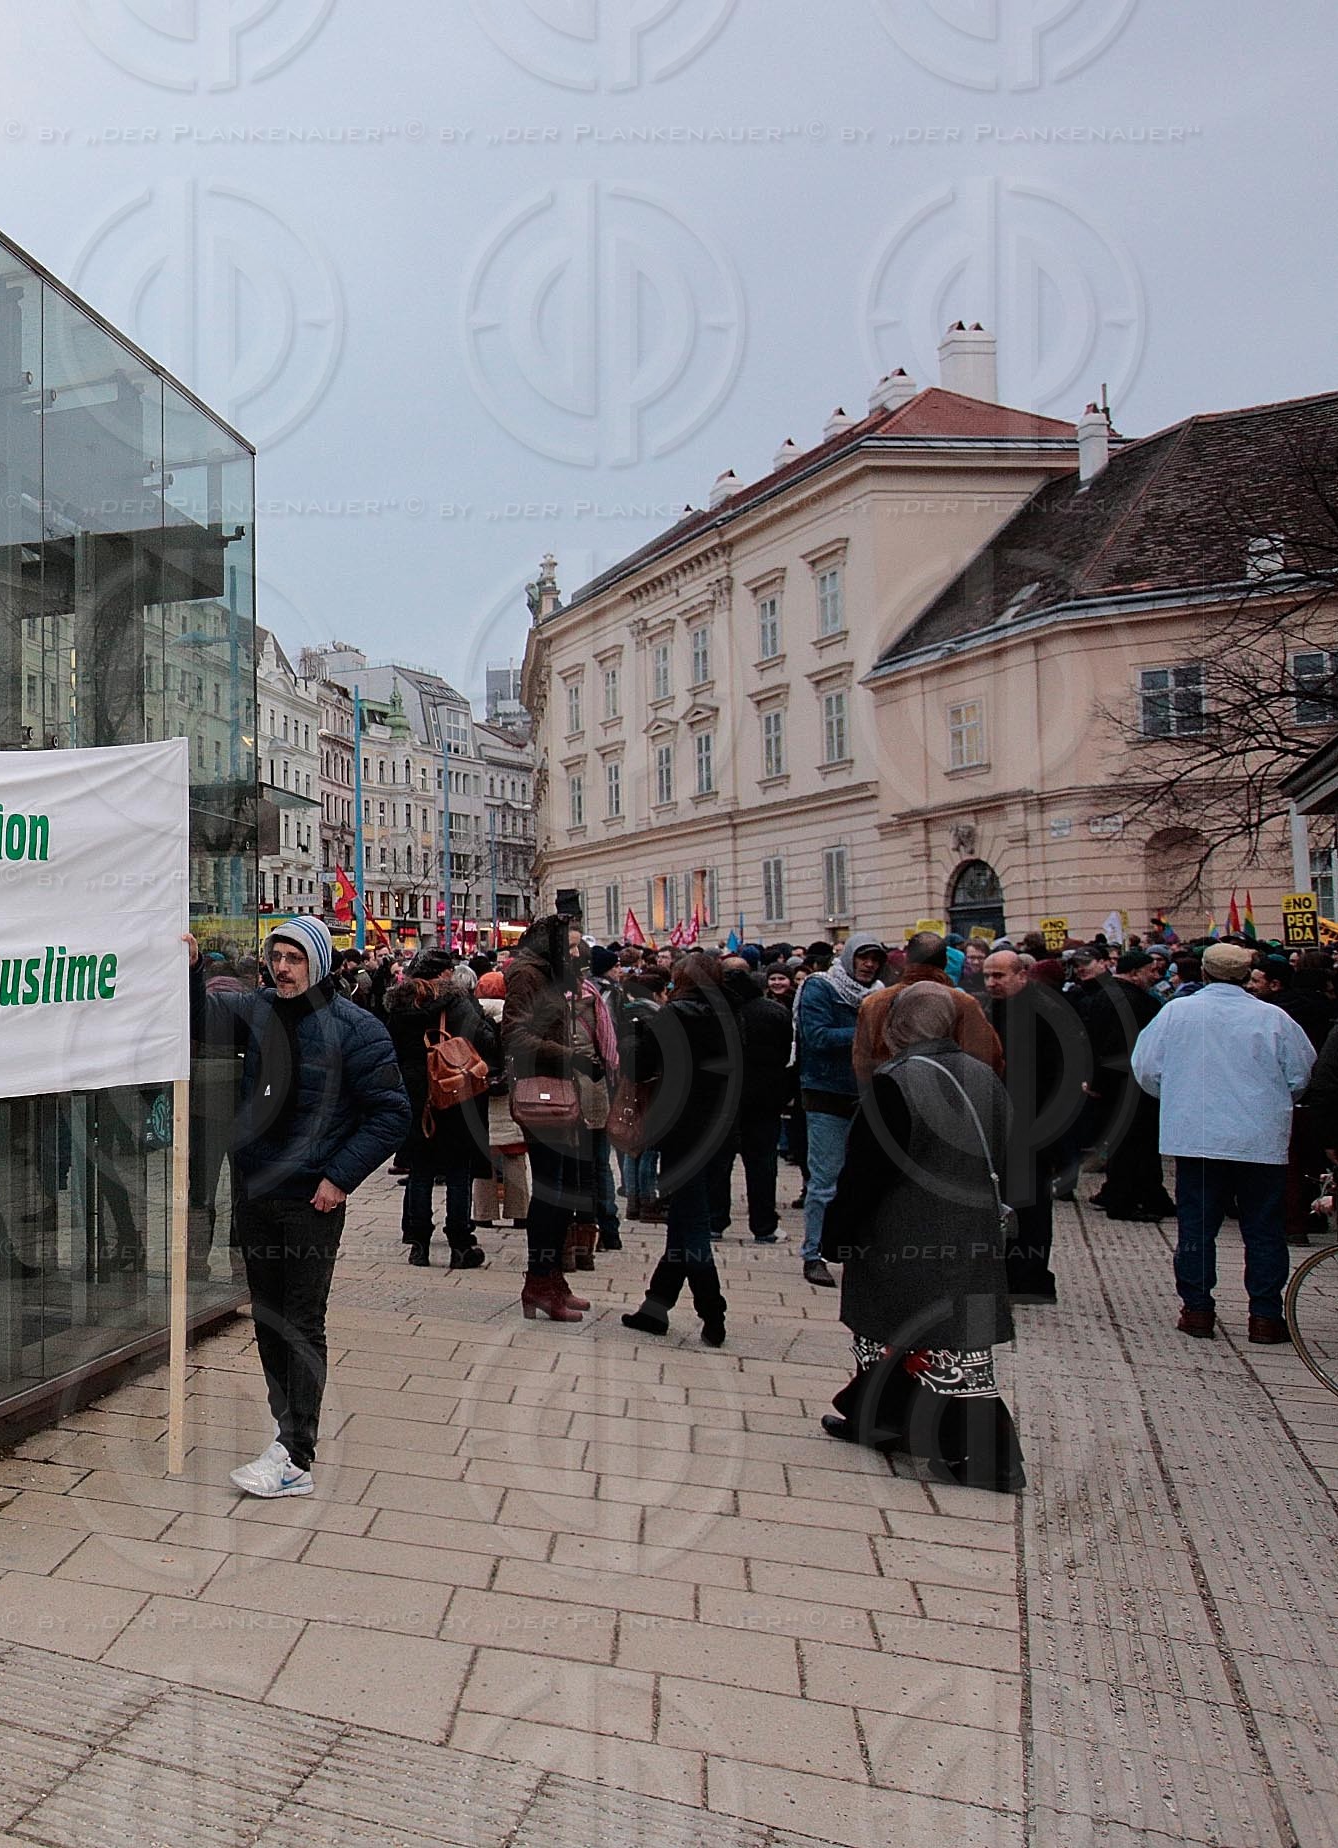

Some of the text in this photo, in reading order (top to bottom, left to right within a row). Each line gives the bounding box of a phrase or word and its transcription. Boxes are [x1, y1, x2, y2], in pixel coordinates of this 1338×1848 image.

[1283, 896, 1313, 910] #NO
[1286, 913, 1314, 927] PEG
[1288, 927, 1315, 940] IDA
